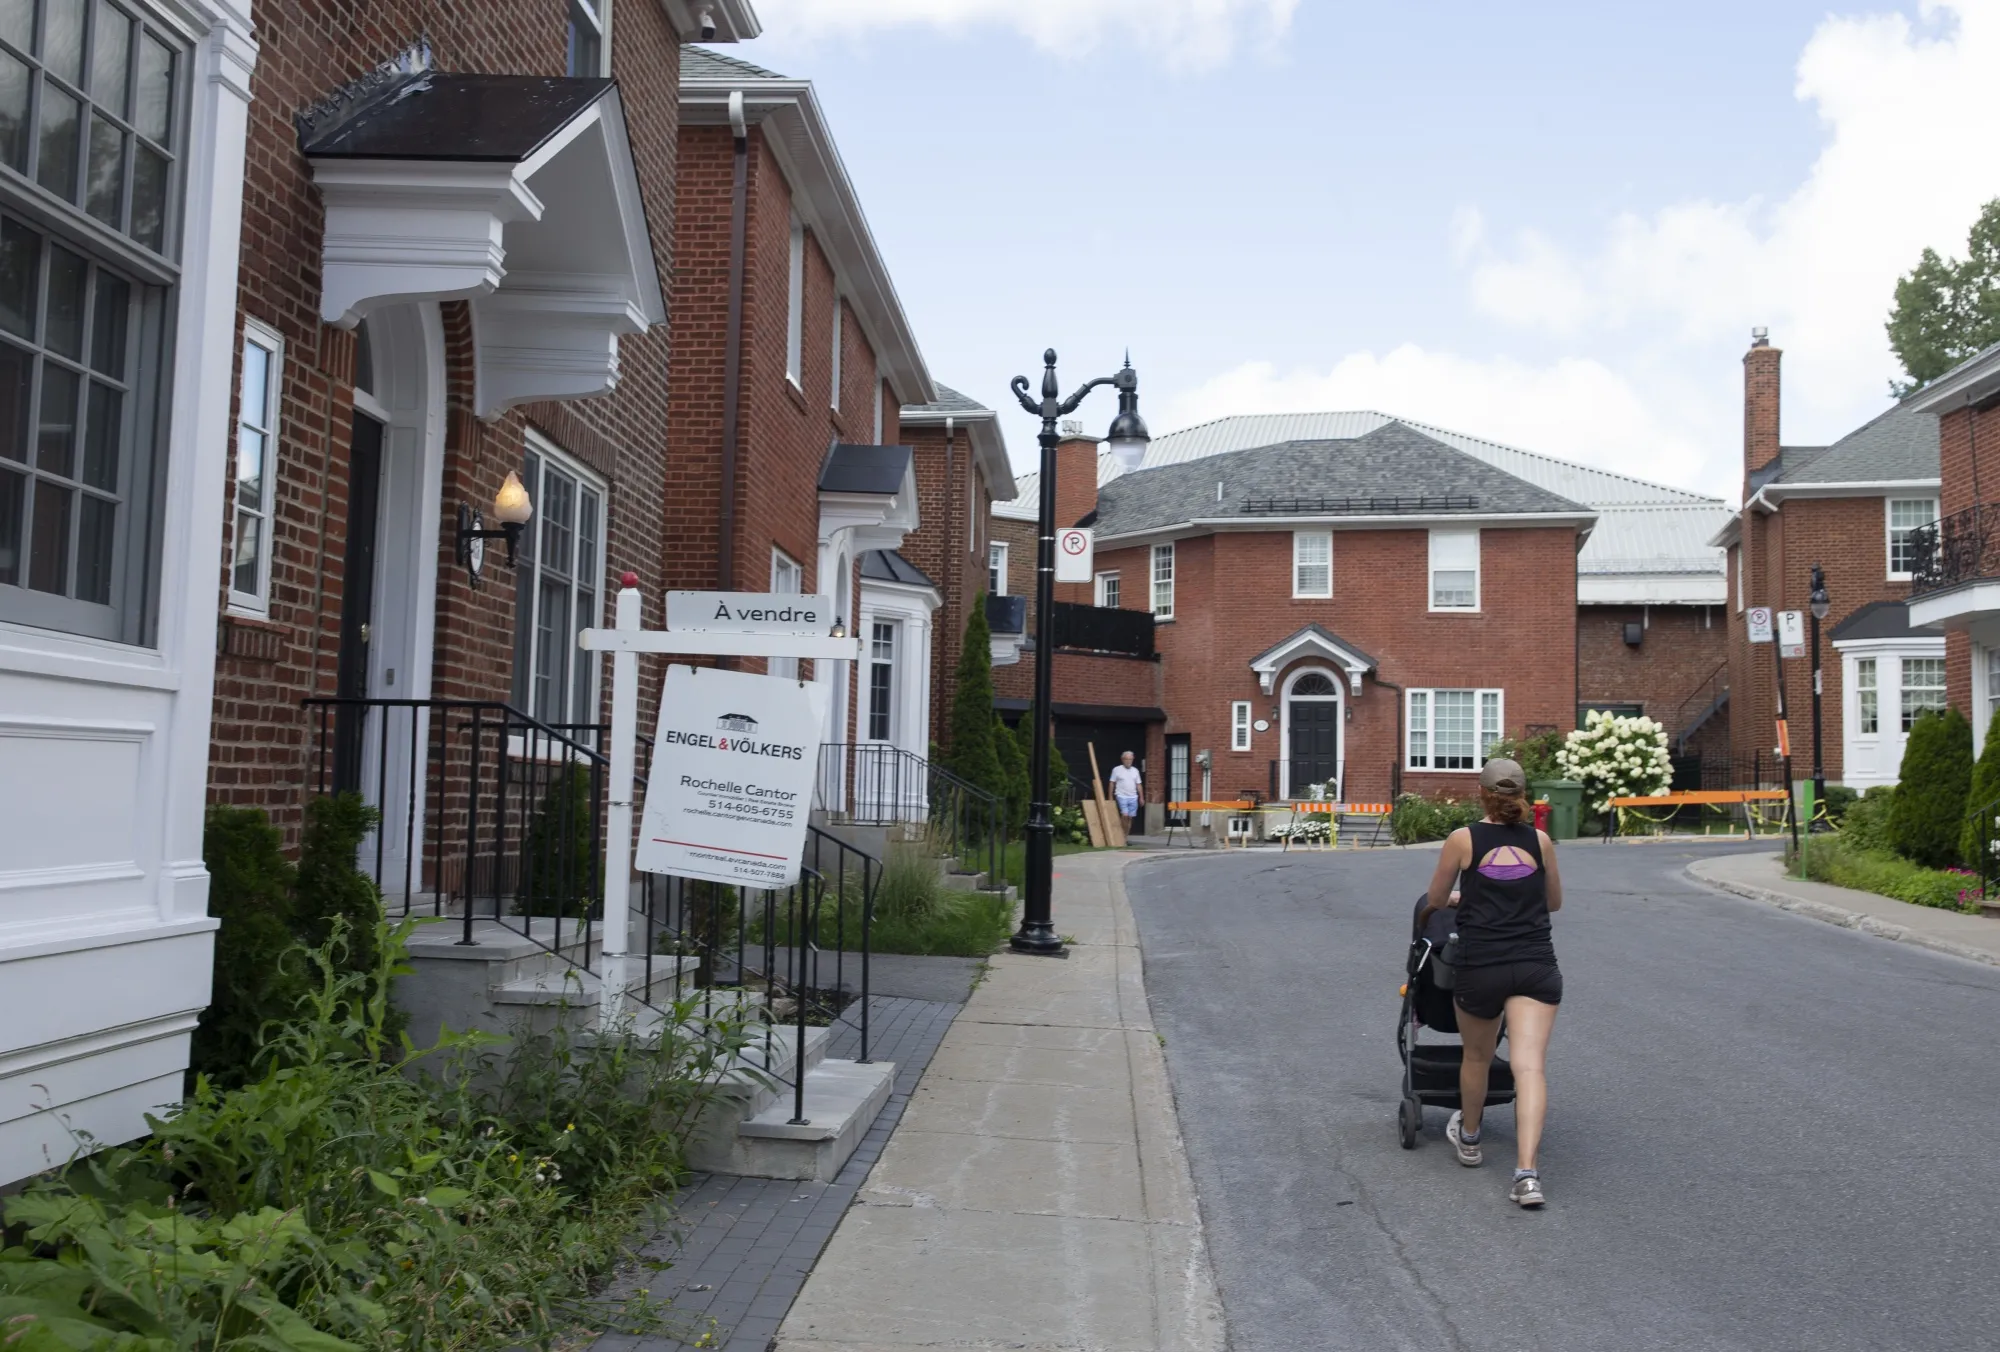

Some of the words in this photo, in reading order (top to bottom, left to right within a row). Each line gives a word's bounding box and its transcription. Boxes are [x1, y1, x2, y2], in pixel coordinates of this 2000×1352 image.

[713, 600, 732, 620] À
[737, 606, 816, 623] vendre
[680, 775, 742, 794] Rochelle
[745, 784, 798, 801] Cantor
[708, 800, 794, 819] 514-605-6755
